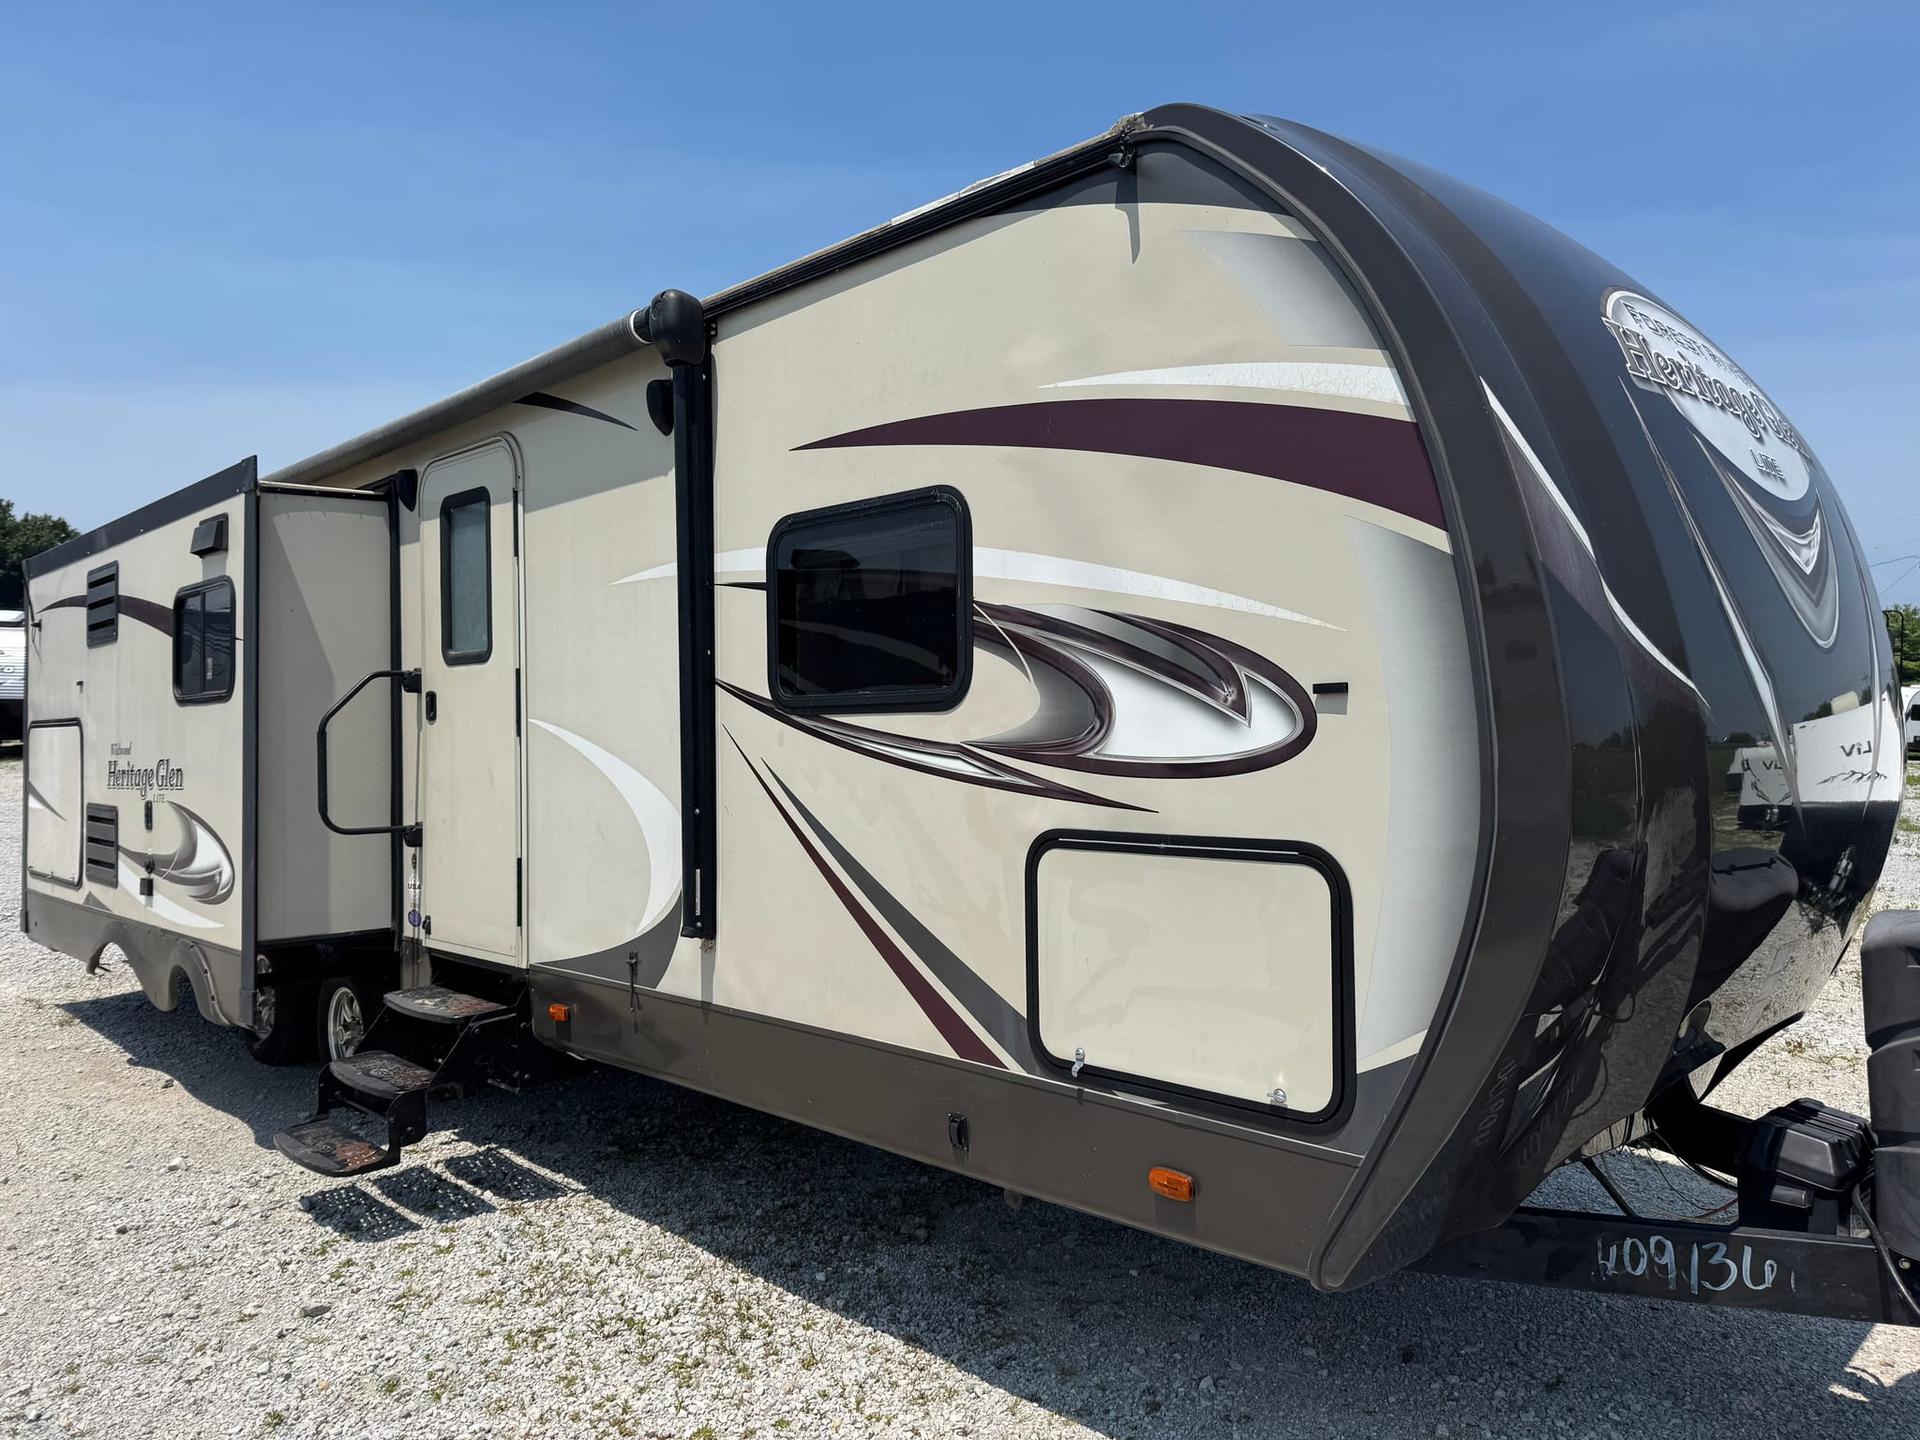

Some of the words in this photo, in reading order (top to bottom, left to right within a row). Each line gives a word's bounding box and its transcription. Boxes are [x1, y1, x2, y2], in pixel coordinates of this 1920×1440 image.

[1601, 317, 1764, 440] Heritage
[107, 760, 154, 800] Heritage
[156, 758, 184, 791] Glen
